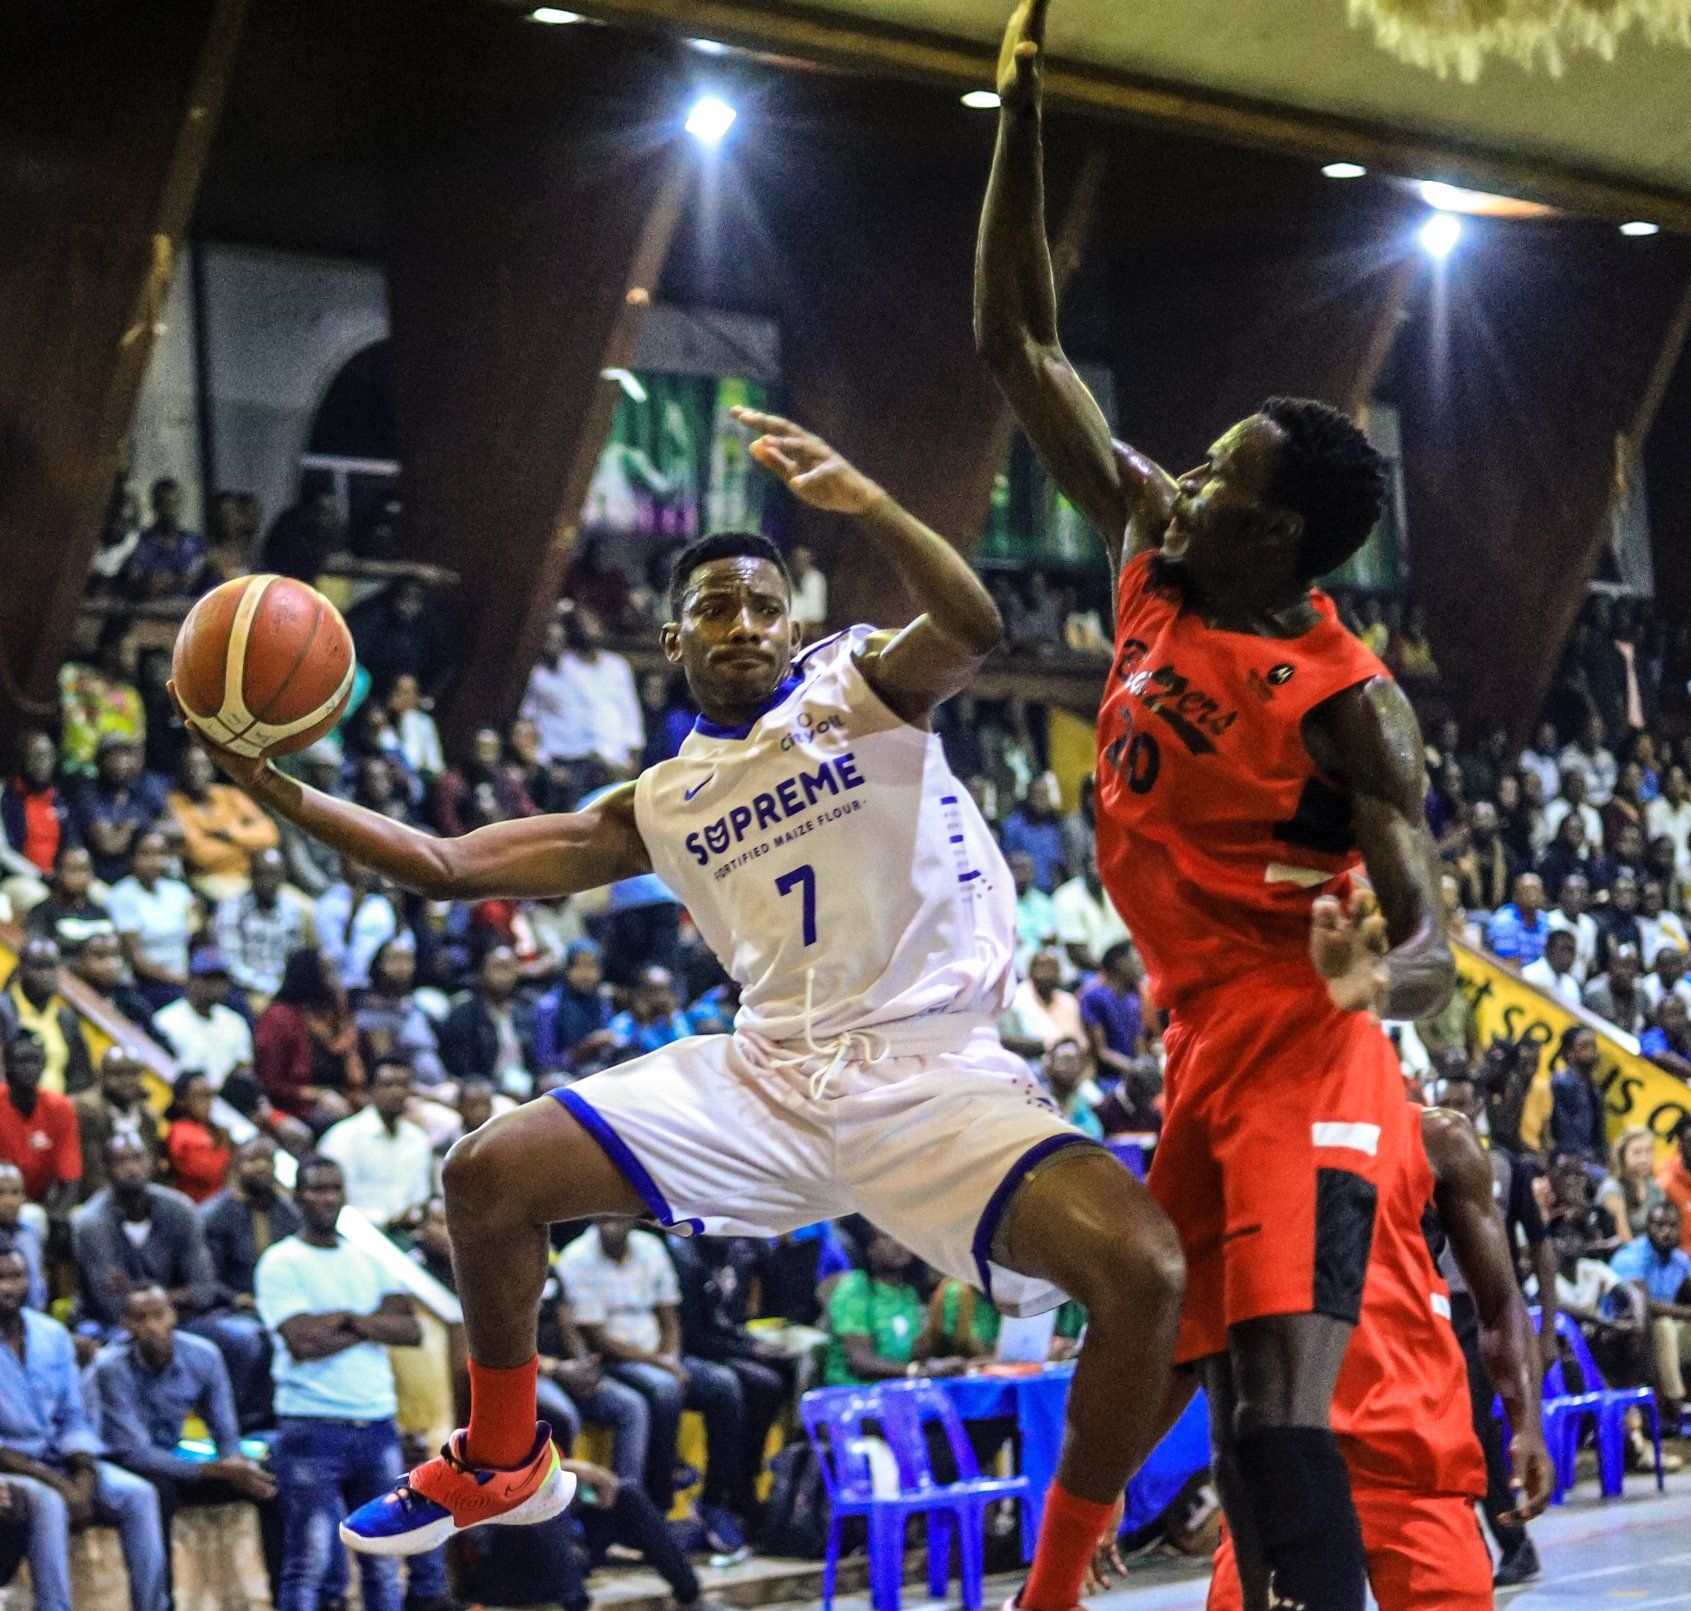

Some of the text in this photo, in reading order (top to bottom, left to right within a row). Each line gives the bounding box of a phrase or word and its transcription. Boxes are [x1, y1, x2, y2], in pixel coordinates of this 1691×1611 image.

[685, 752, 866, 866] SUPREME
[713, 799, 862, 882] FORTIFIED MAIZE FLOUR
[774, 863, 817, 947] 7
